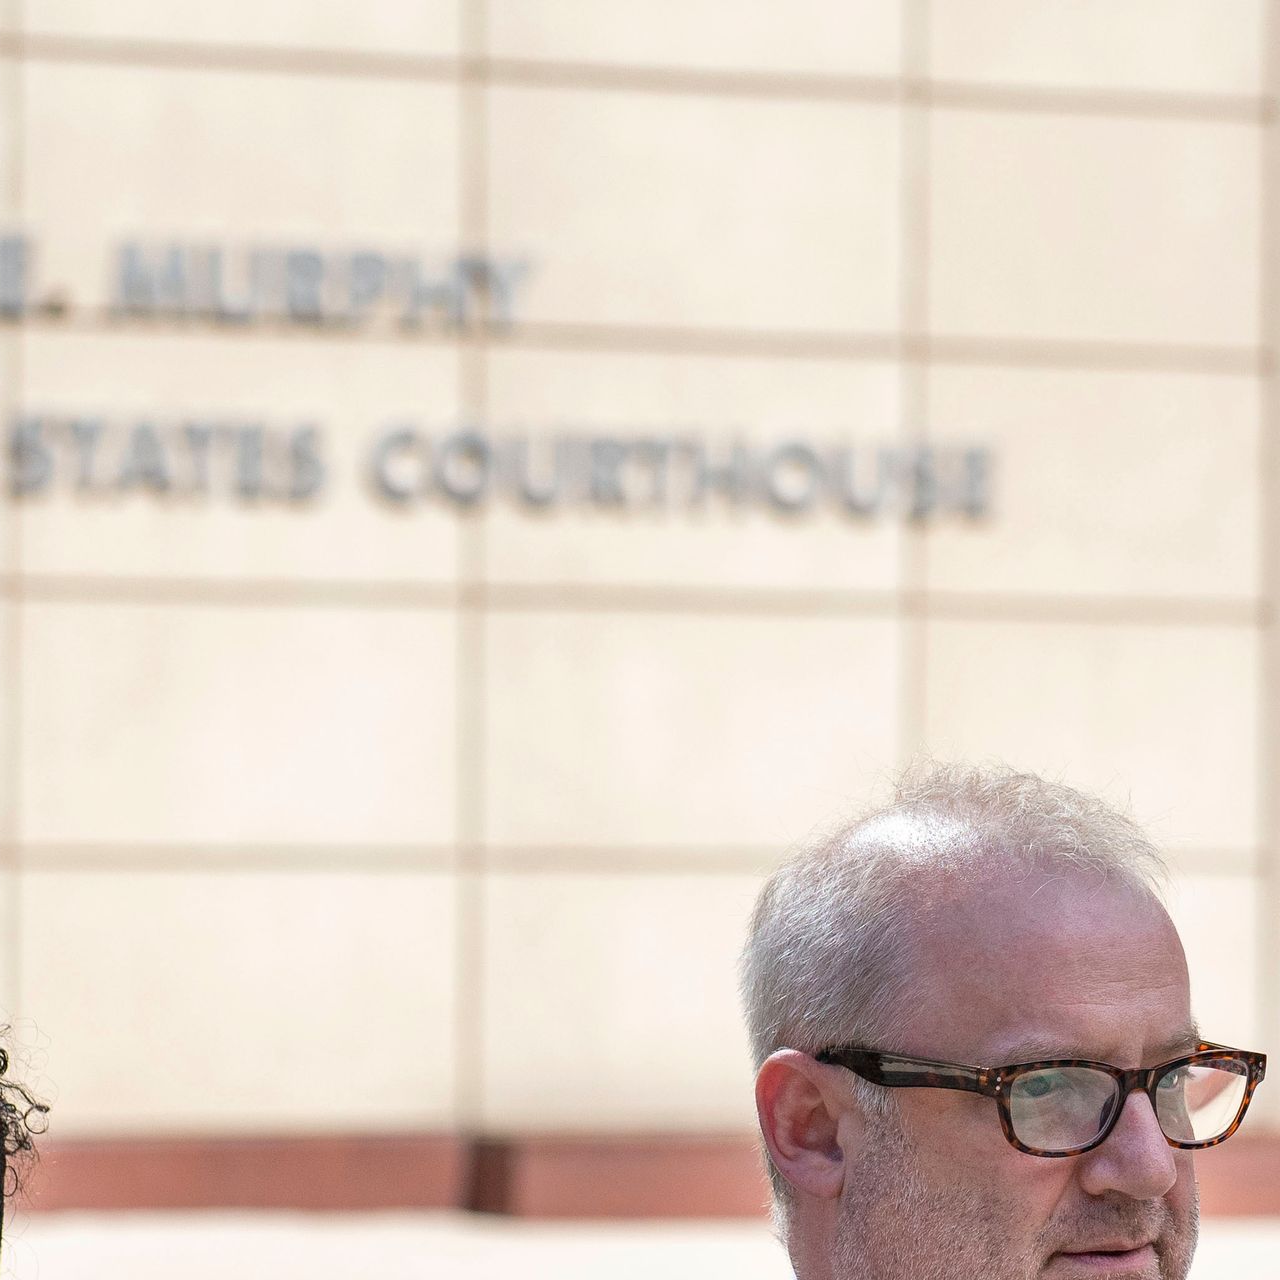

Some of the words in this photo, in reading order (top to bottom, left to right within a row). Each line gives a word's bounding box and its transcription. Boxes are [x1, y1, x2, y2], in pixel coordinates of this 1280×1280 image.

[116, 243, 532, 330] MURPHY
[6, 413, 326, 503] STATES
[372, 428, 998, 522] COURTHOUSE
